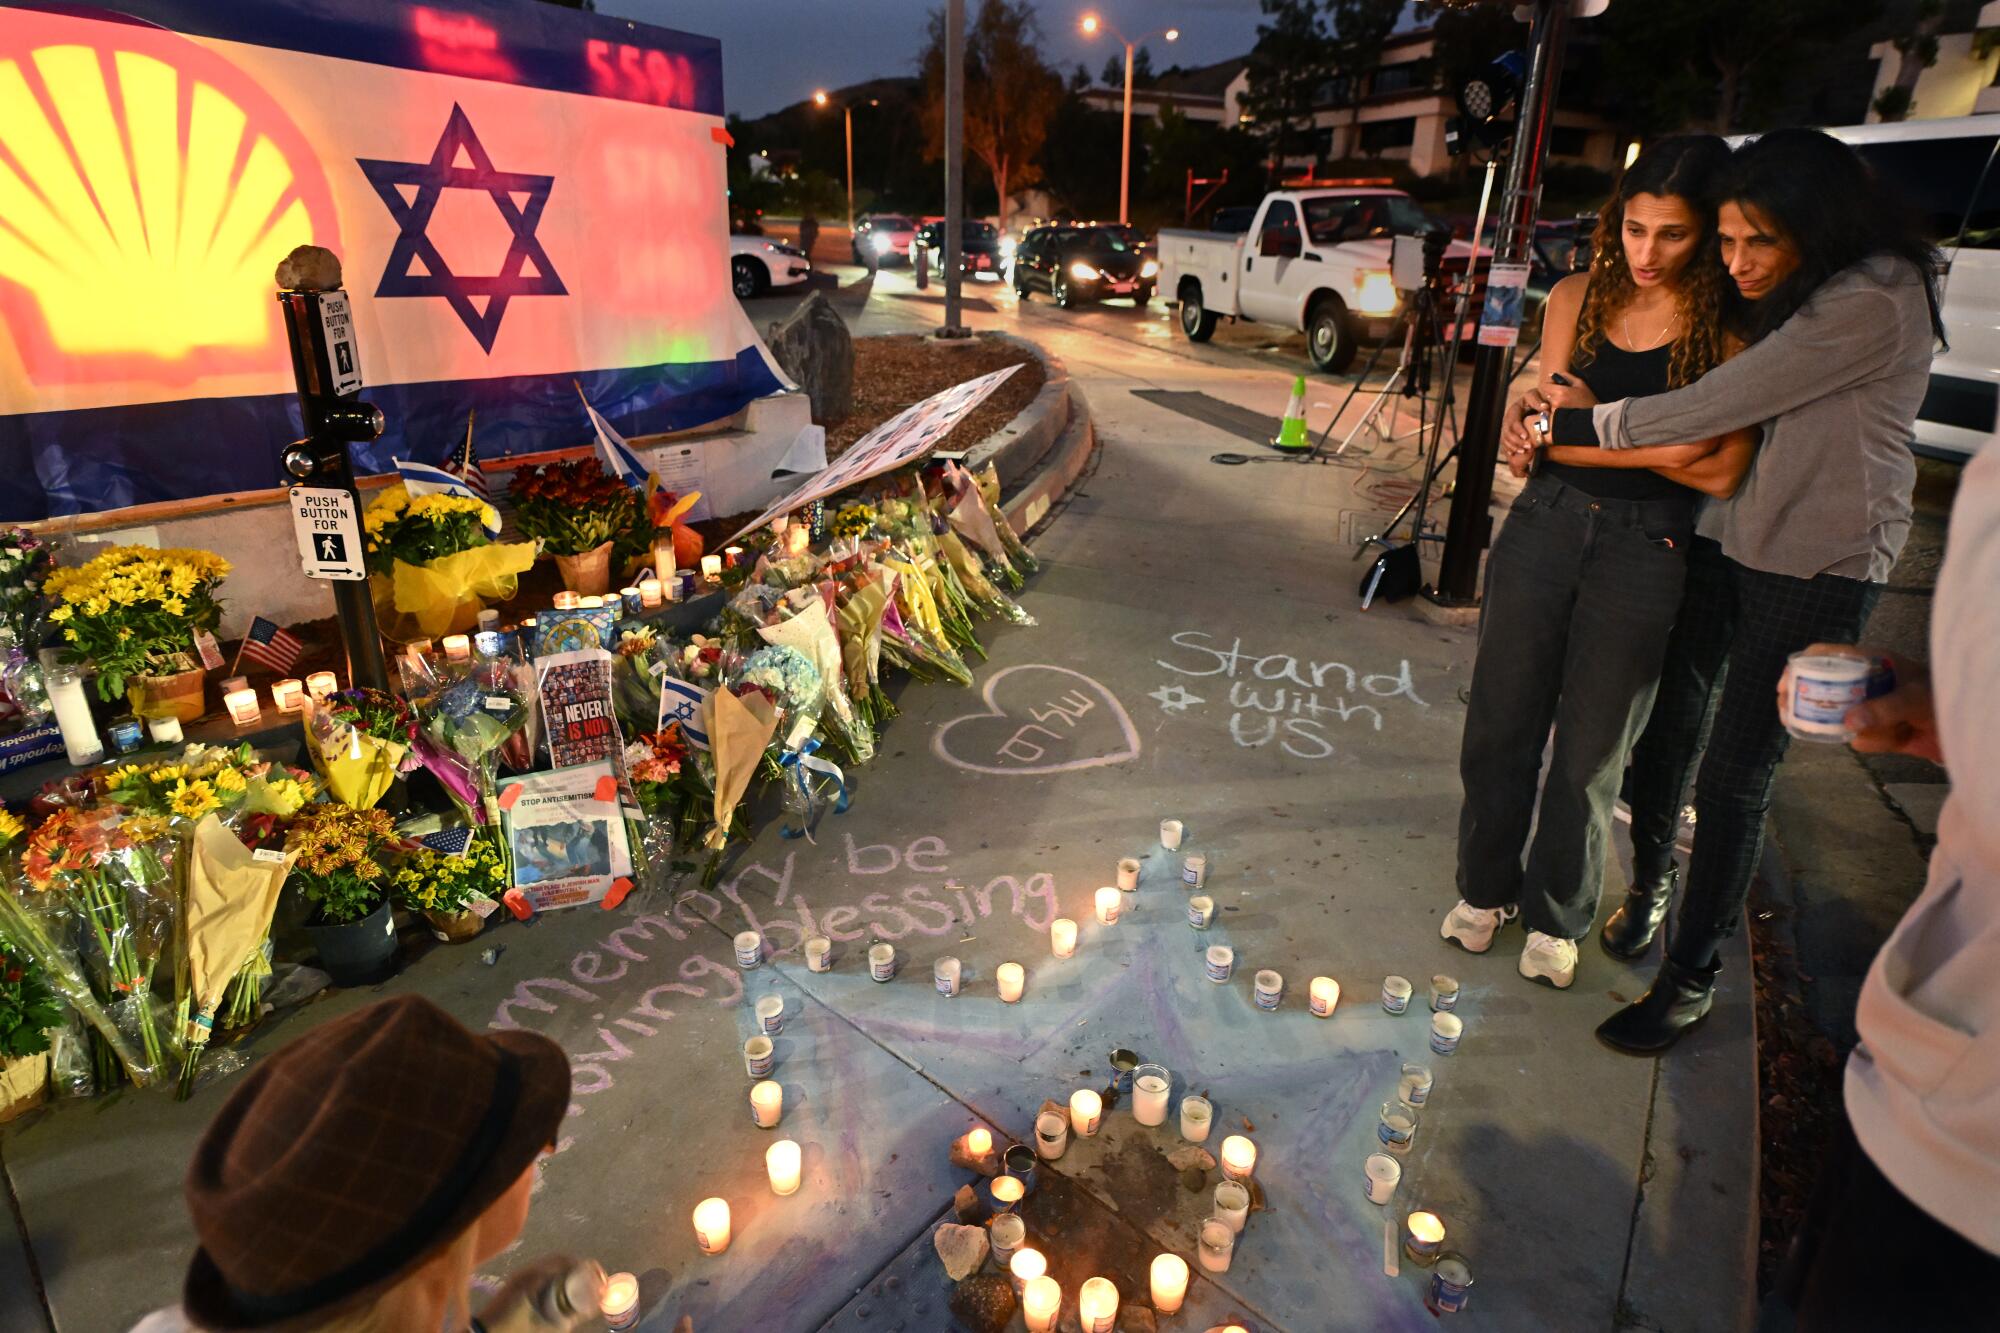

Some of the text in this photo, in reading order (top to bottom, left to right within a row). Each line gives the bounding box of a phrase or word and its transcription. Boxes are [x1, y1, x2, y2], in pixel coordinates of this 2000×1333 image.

[326, 301, 344, 314] PUSH
[325, 313, 350, 328] BUTTON
[333, 327, 346, 339] FOR
[305, 496, 339, 507] PUSH
[300, 508, 349, 519] BUTTON
[314, 520, 338, 530] FOR
[1156, 630, 1431, 708] Stand
[565, 700, 604, 723] NEVER
[0, 727, 60, 747] Reynolds
[568, 722, 582, 740] IS
[521, 792, 595, 807] STOP ANTISEMITISM
[488, 832, 950, 1029] memory be
[566, 871, 1060, 1117] oving blessing
